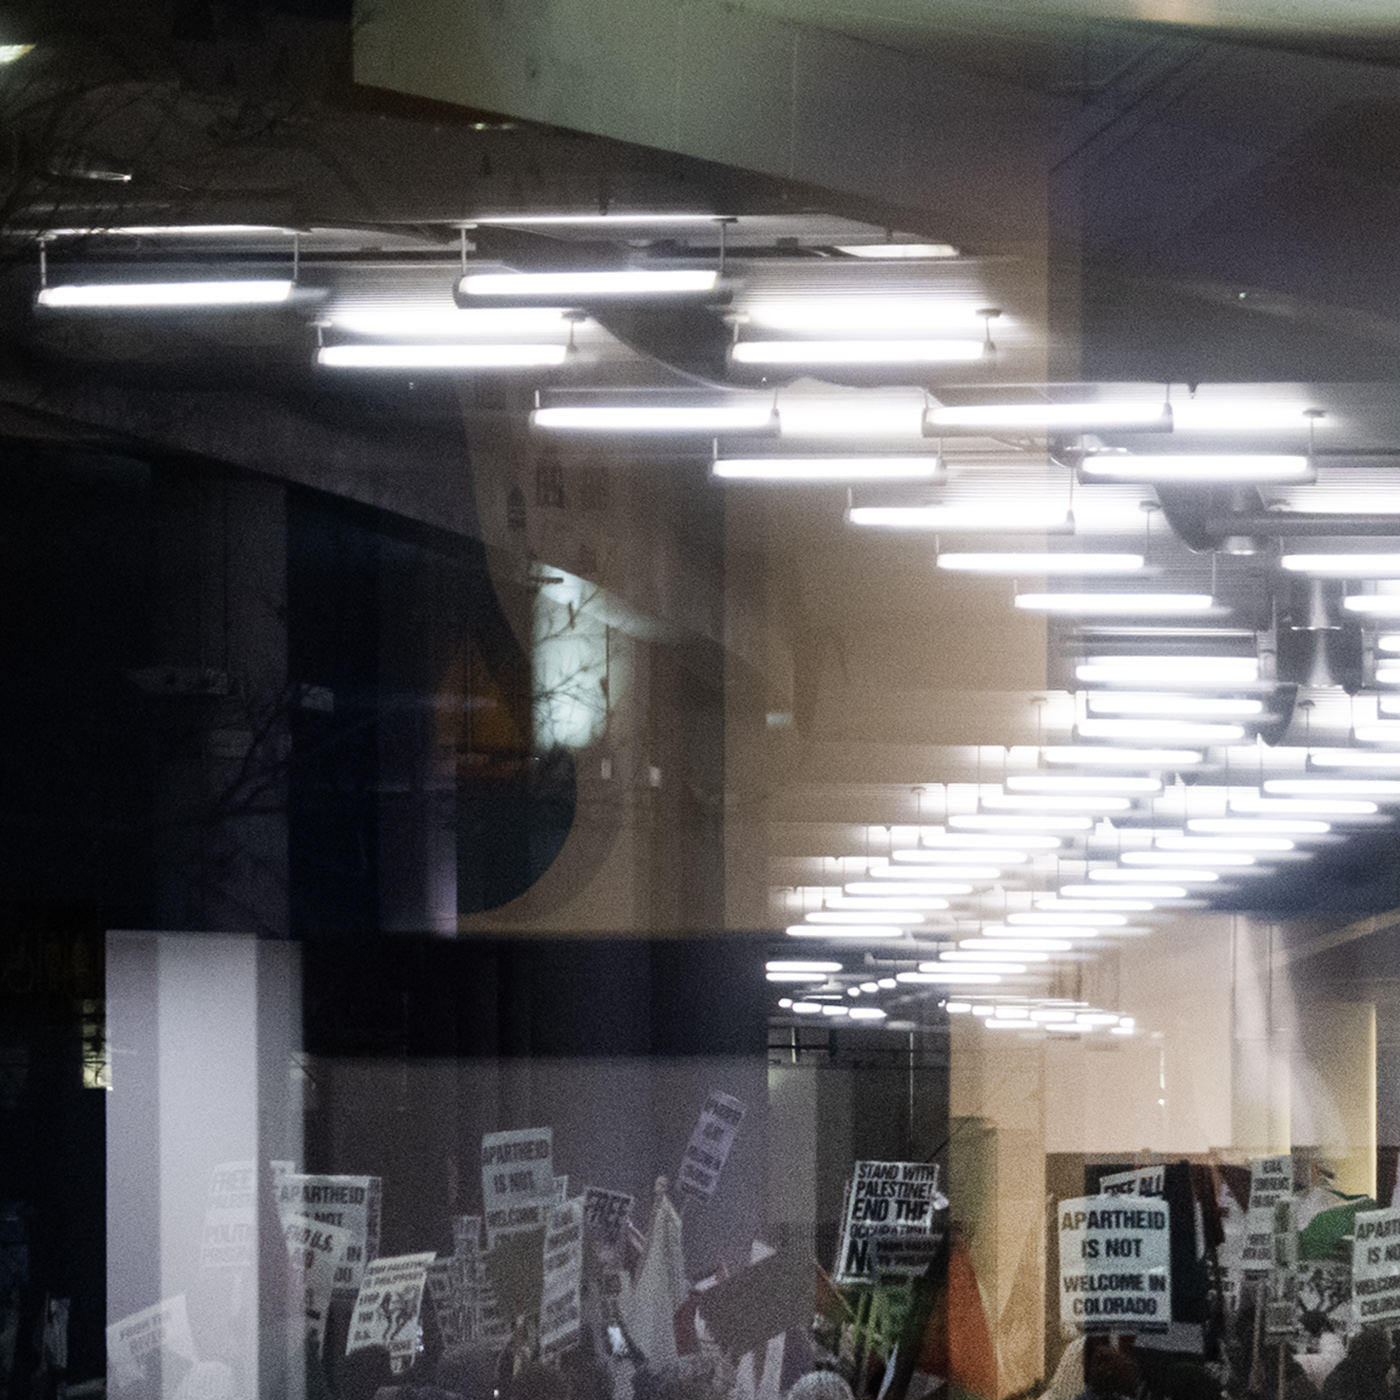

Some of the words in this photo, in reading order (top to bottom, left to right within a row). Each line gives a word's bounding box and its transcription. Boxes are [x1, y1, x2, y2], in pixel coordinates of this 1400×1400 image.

[482, 1139, 549, 1164] APARTHEID
[494, 1174, 507, 1193] IS
[510, 1171, 535, 1192] NOT
[859, 1163, 899, 1180] STAND
[903, 1164, 935, 1182] WITH
[857, 1180, 933, 1200] PALESTINE!
[852, 1196, 890, 1222] END
[1061, 1209, 1166, 1231] APARTHEID
[1081, 1239, 1100, 1258] IS
[1105, 1238, 1144, 1258] NOT
[1367, 1246, 1381, 1265] IS
[1063, 1272, 1145, 1293] WELCOME
[1148, 1274, 1167, 1292] IN
[1072, 1296, 1158, 1316] COLORADO
